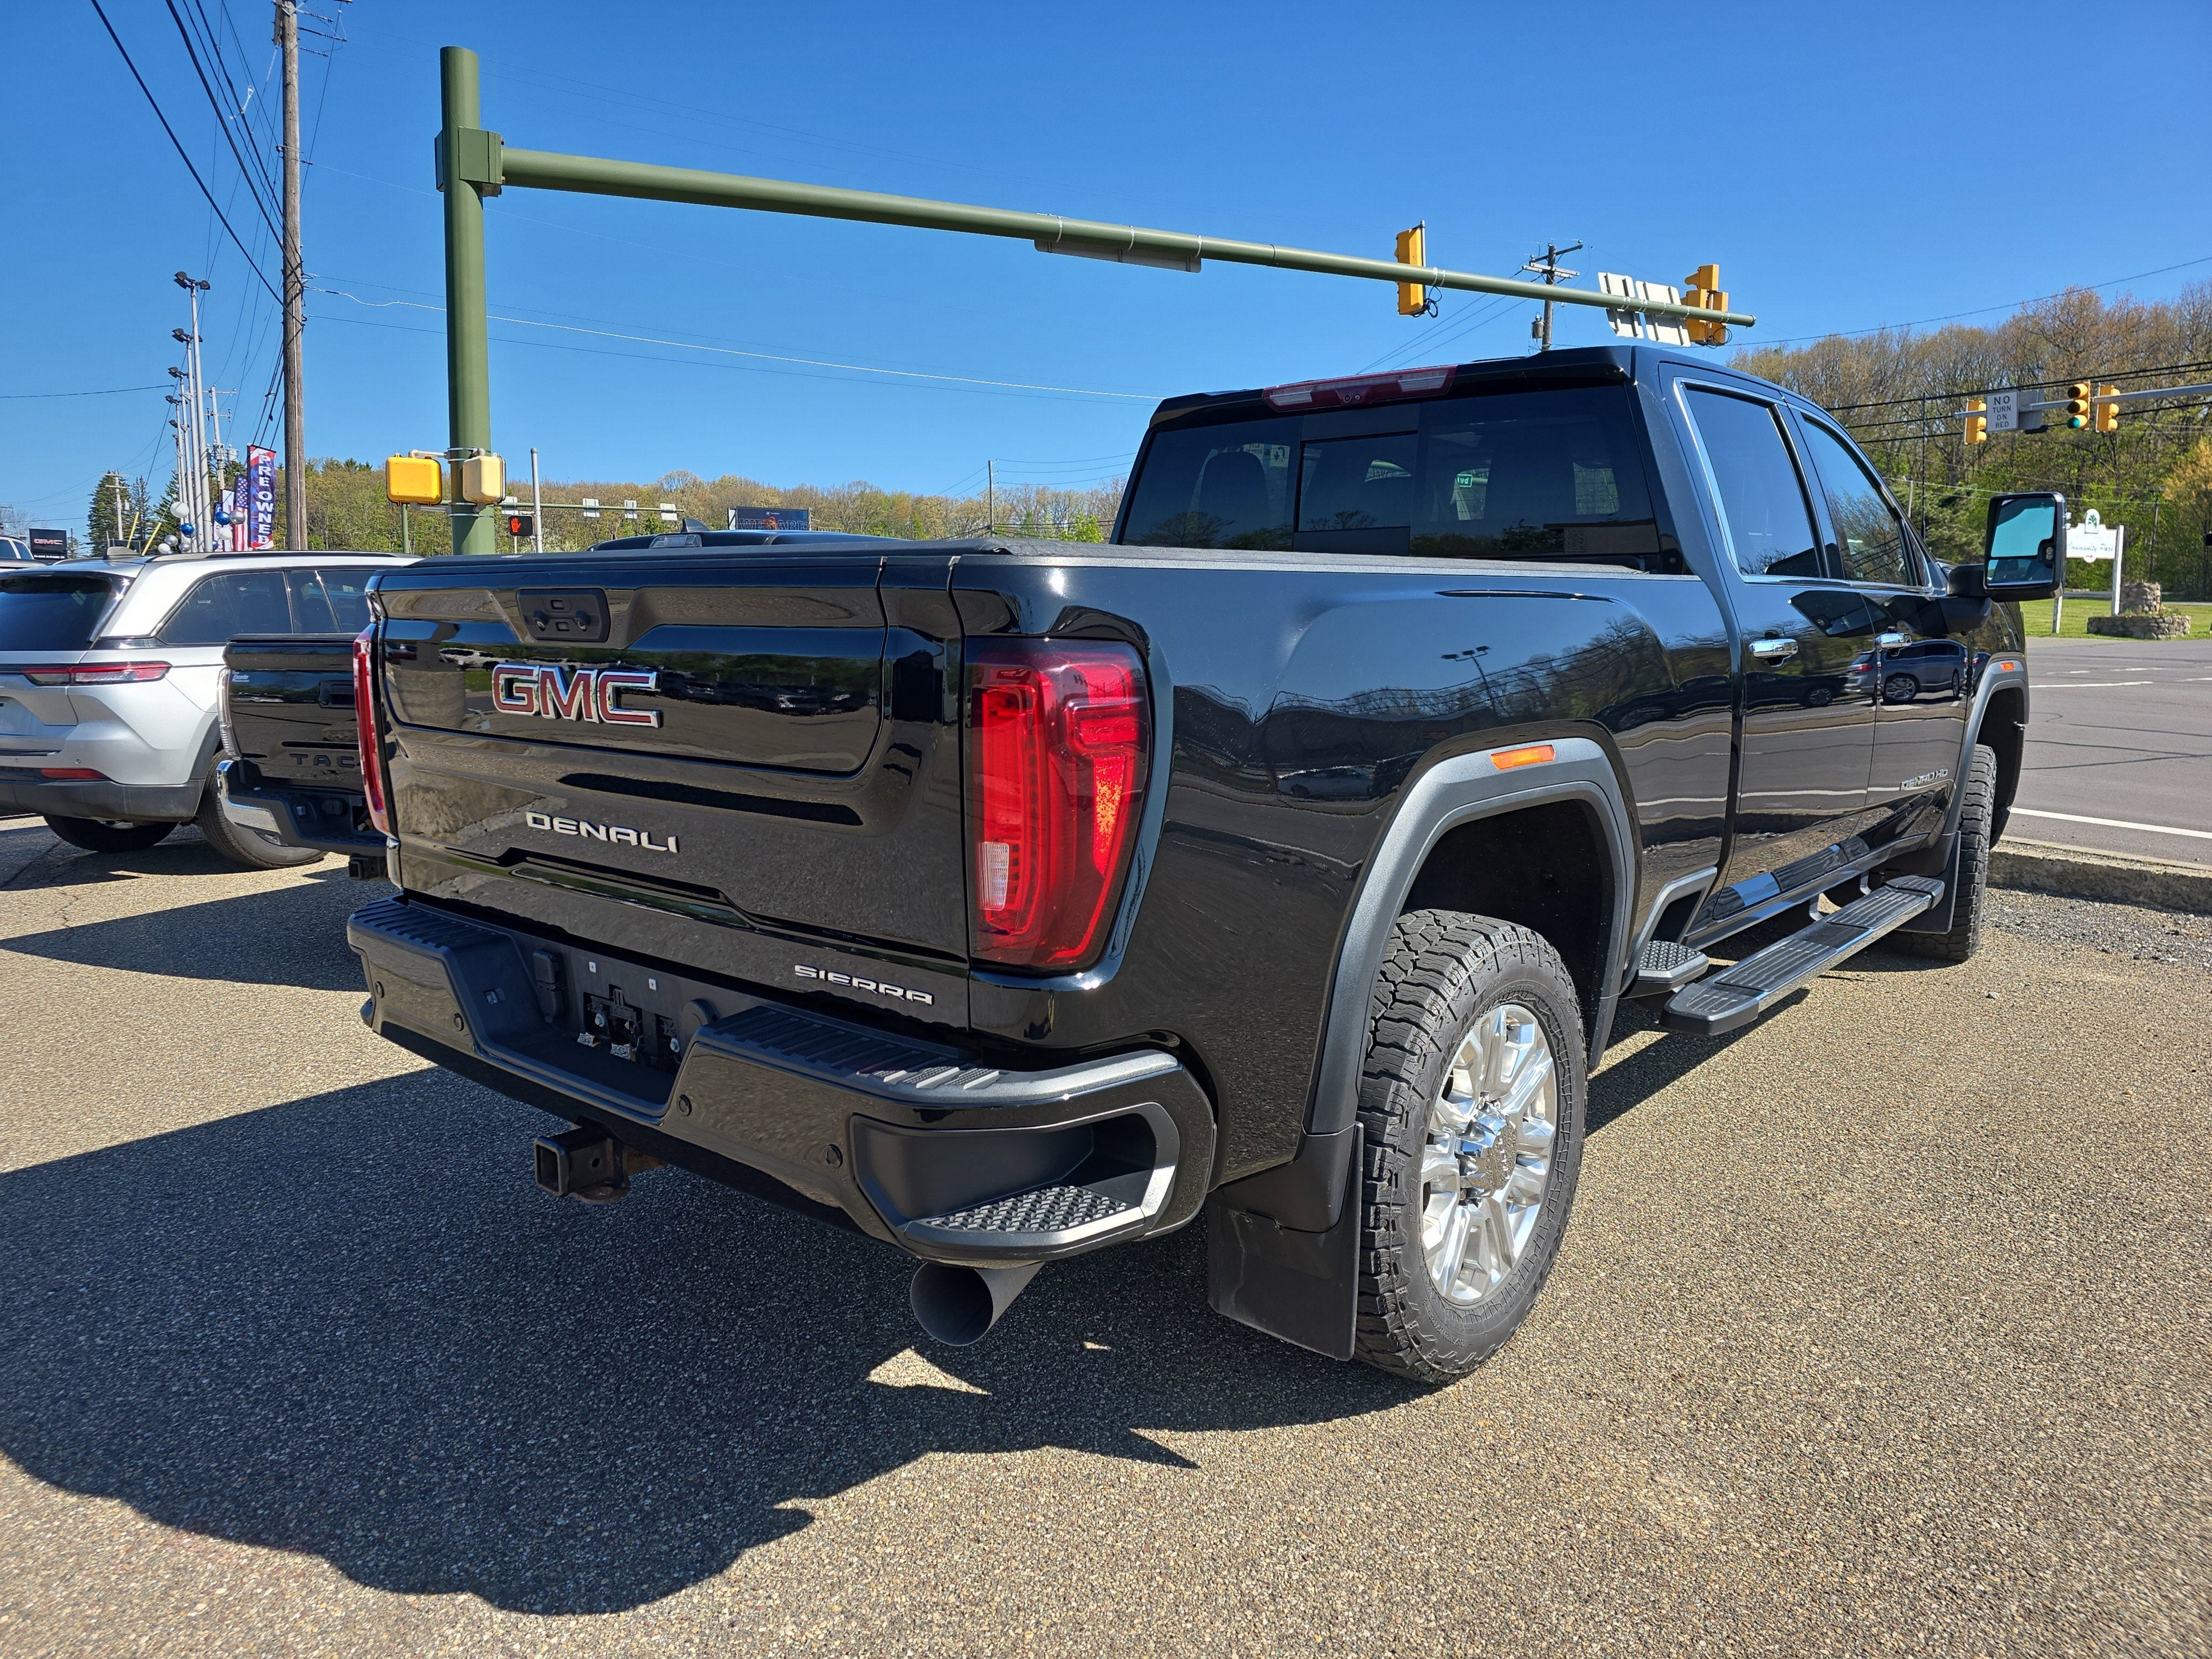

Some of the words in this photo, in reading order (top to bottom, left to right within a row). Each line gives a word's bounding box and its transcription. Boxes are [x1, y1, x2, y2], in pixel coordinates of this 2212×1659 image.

[1992, 405, 2011, 413] TURN
[1994, 395, 2010, 406] NO
[258, 454, 272, 487] PRE
[256, 491, 274, 544] OWNED
[492, 663, 664, 728] GMC
[526, 811, 679, 853] DENALI
[795, 964, 934, 1006] SIERRA
